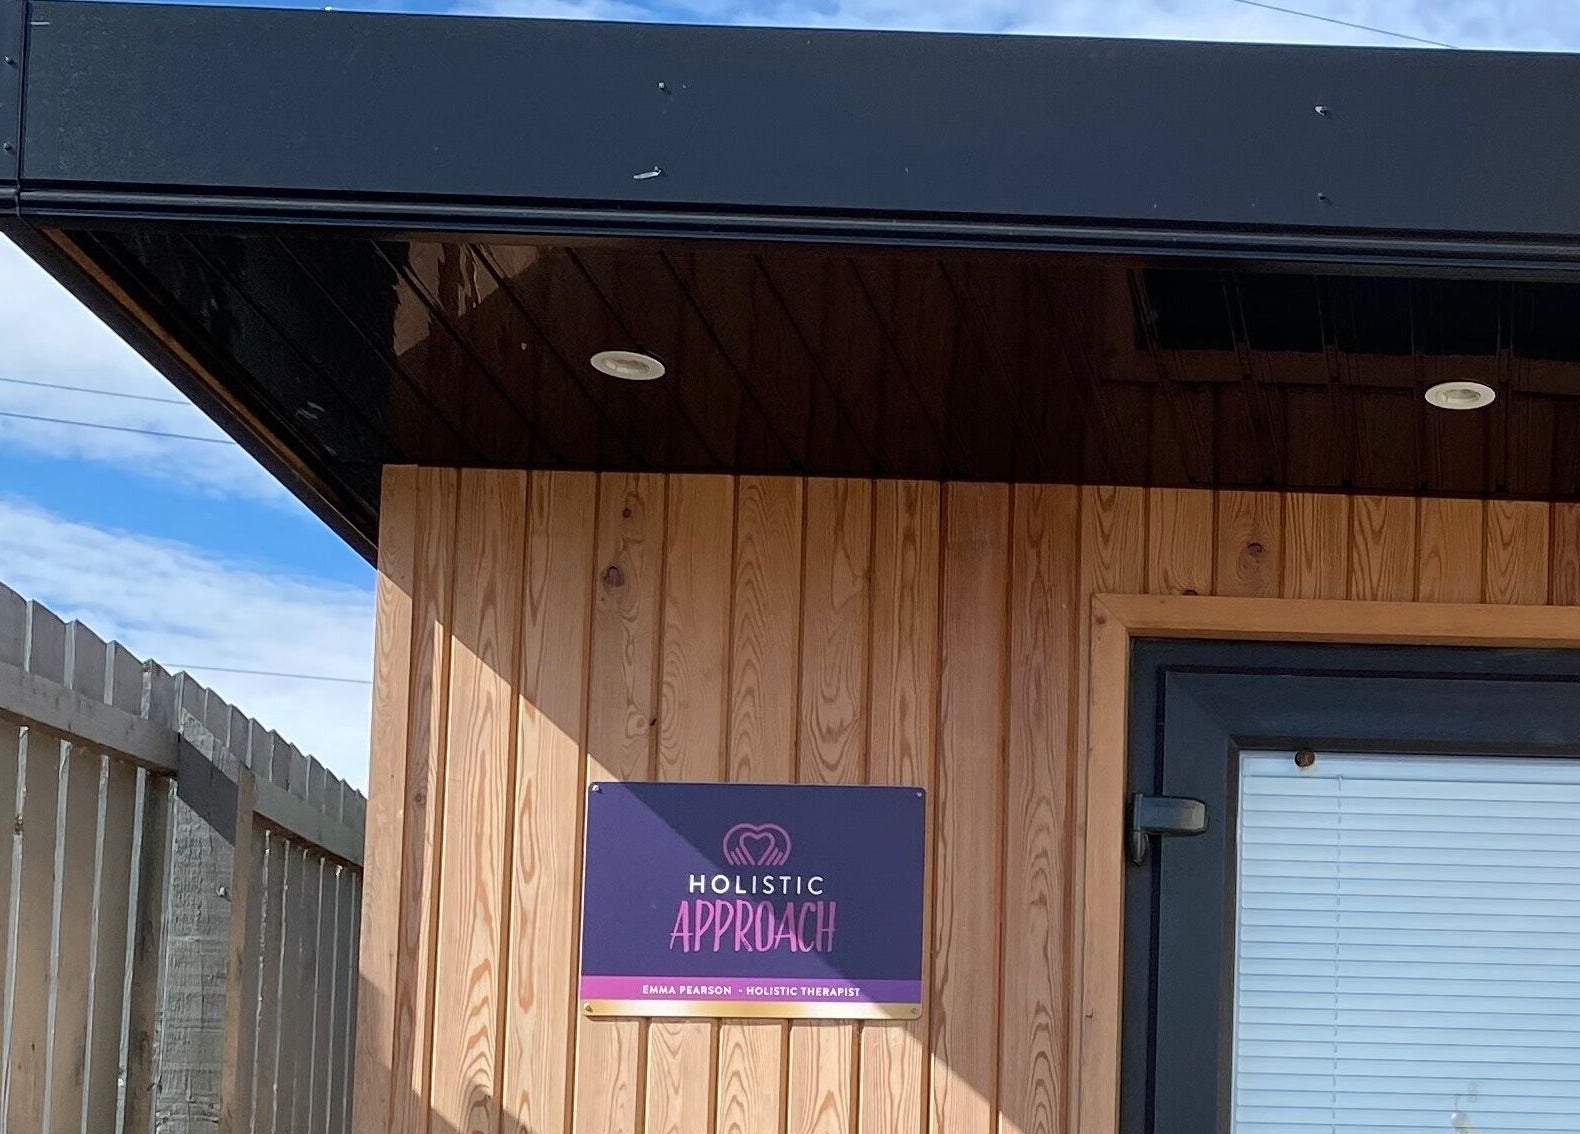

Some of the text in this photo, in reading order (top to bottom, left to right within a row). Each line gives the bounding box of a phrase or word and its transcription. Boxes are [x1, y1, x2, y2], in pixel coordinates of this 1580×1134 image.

[689, 874, 824, 895] HOLISTIC
[669, 899, 837, 953] APPROACH
[642, 984, 676, 995] EMMA
[679, 985, 732, 996] PEARSON
[746, 986, 798, 997] HOLISTIC
[800, 987, 861, 998] THERAPIST
